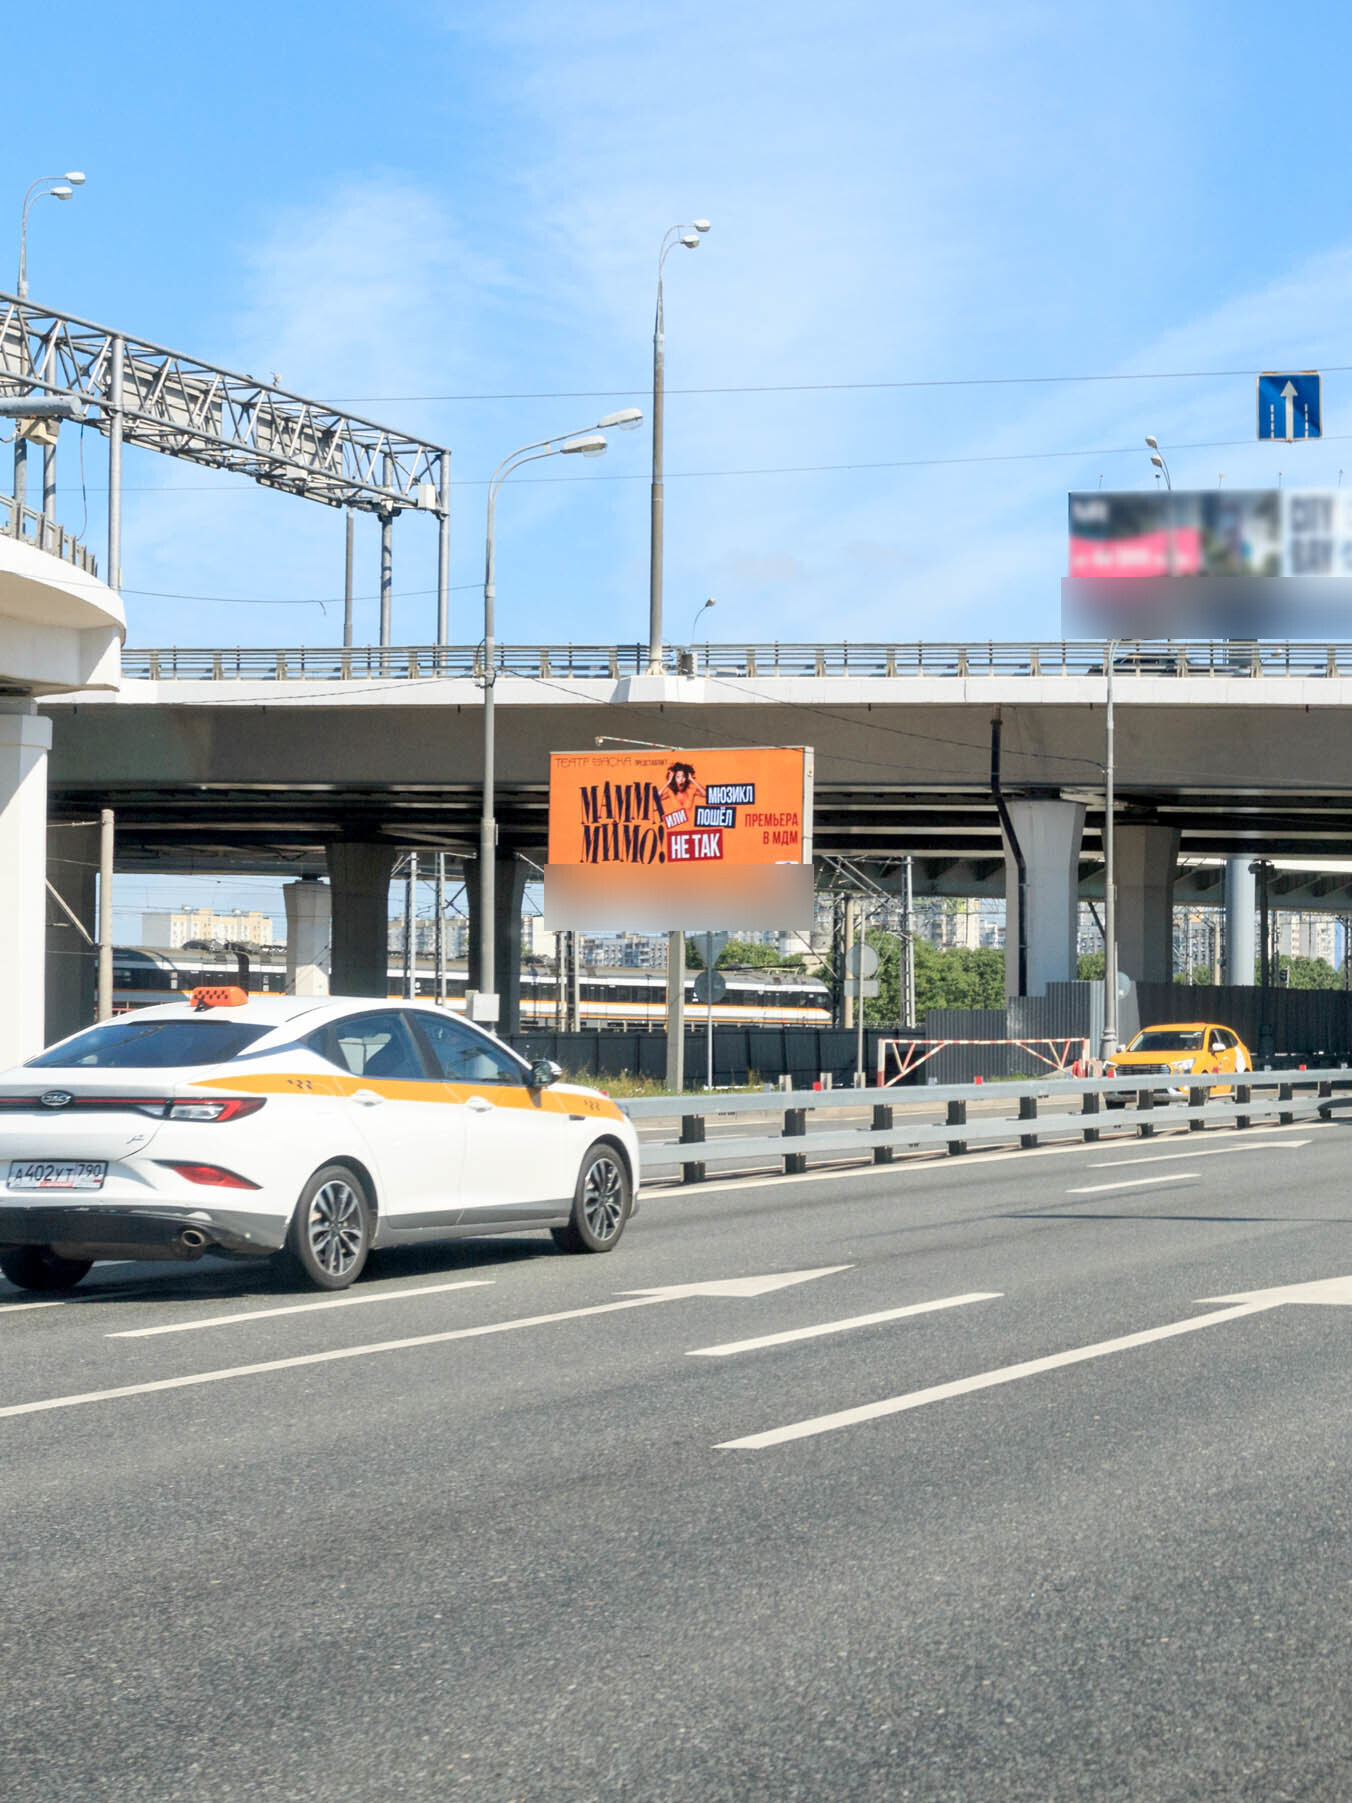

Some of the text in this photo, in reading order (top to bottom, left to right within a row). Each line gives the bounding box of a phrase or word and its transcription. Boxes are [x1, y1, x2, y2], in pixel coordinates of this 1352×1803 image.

[579, 781, 665, 824] МАММА
[708, 785, 753, 804] МЮЗИКЛ
[665, 809, 687, 828] ИЛИ
[697, 807, 732, 826] ПОШЁЛ
[745, 812, 799, 828] ПРЕМЬЕРА
[580, 821, 665, 864] МИМО!
[672, 832, 720, 859] НЕ ТАК
[763, 830, 798, 846] В МДМ
[78, 1164, 101, 1177] 790
